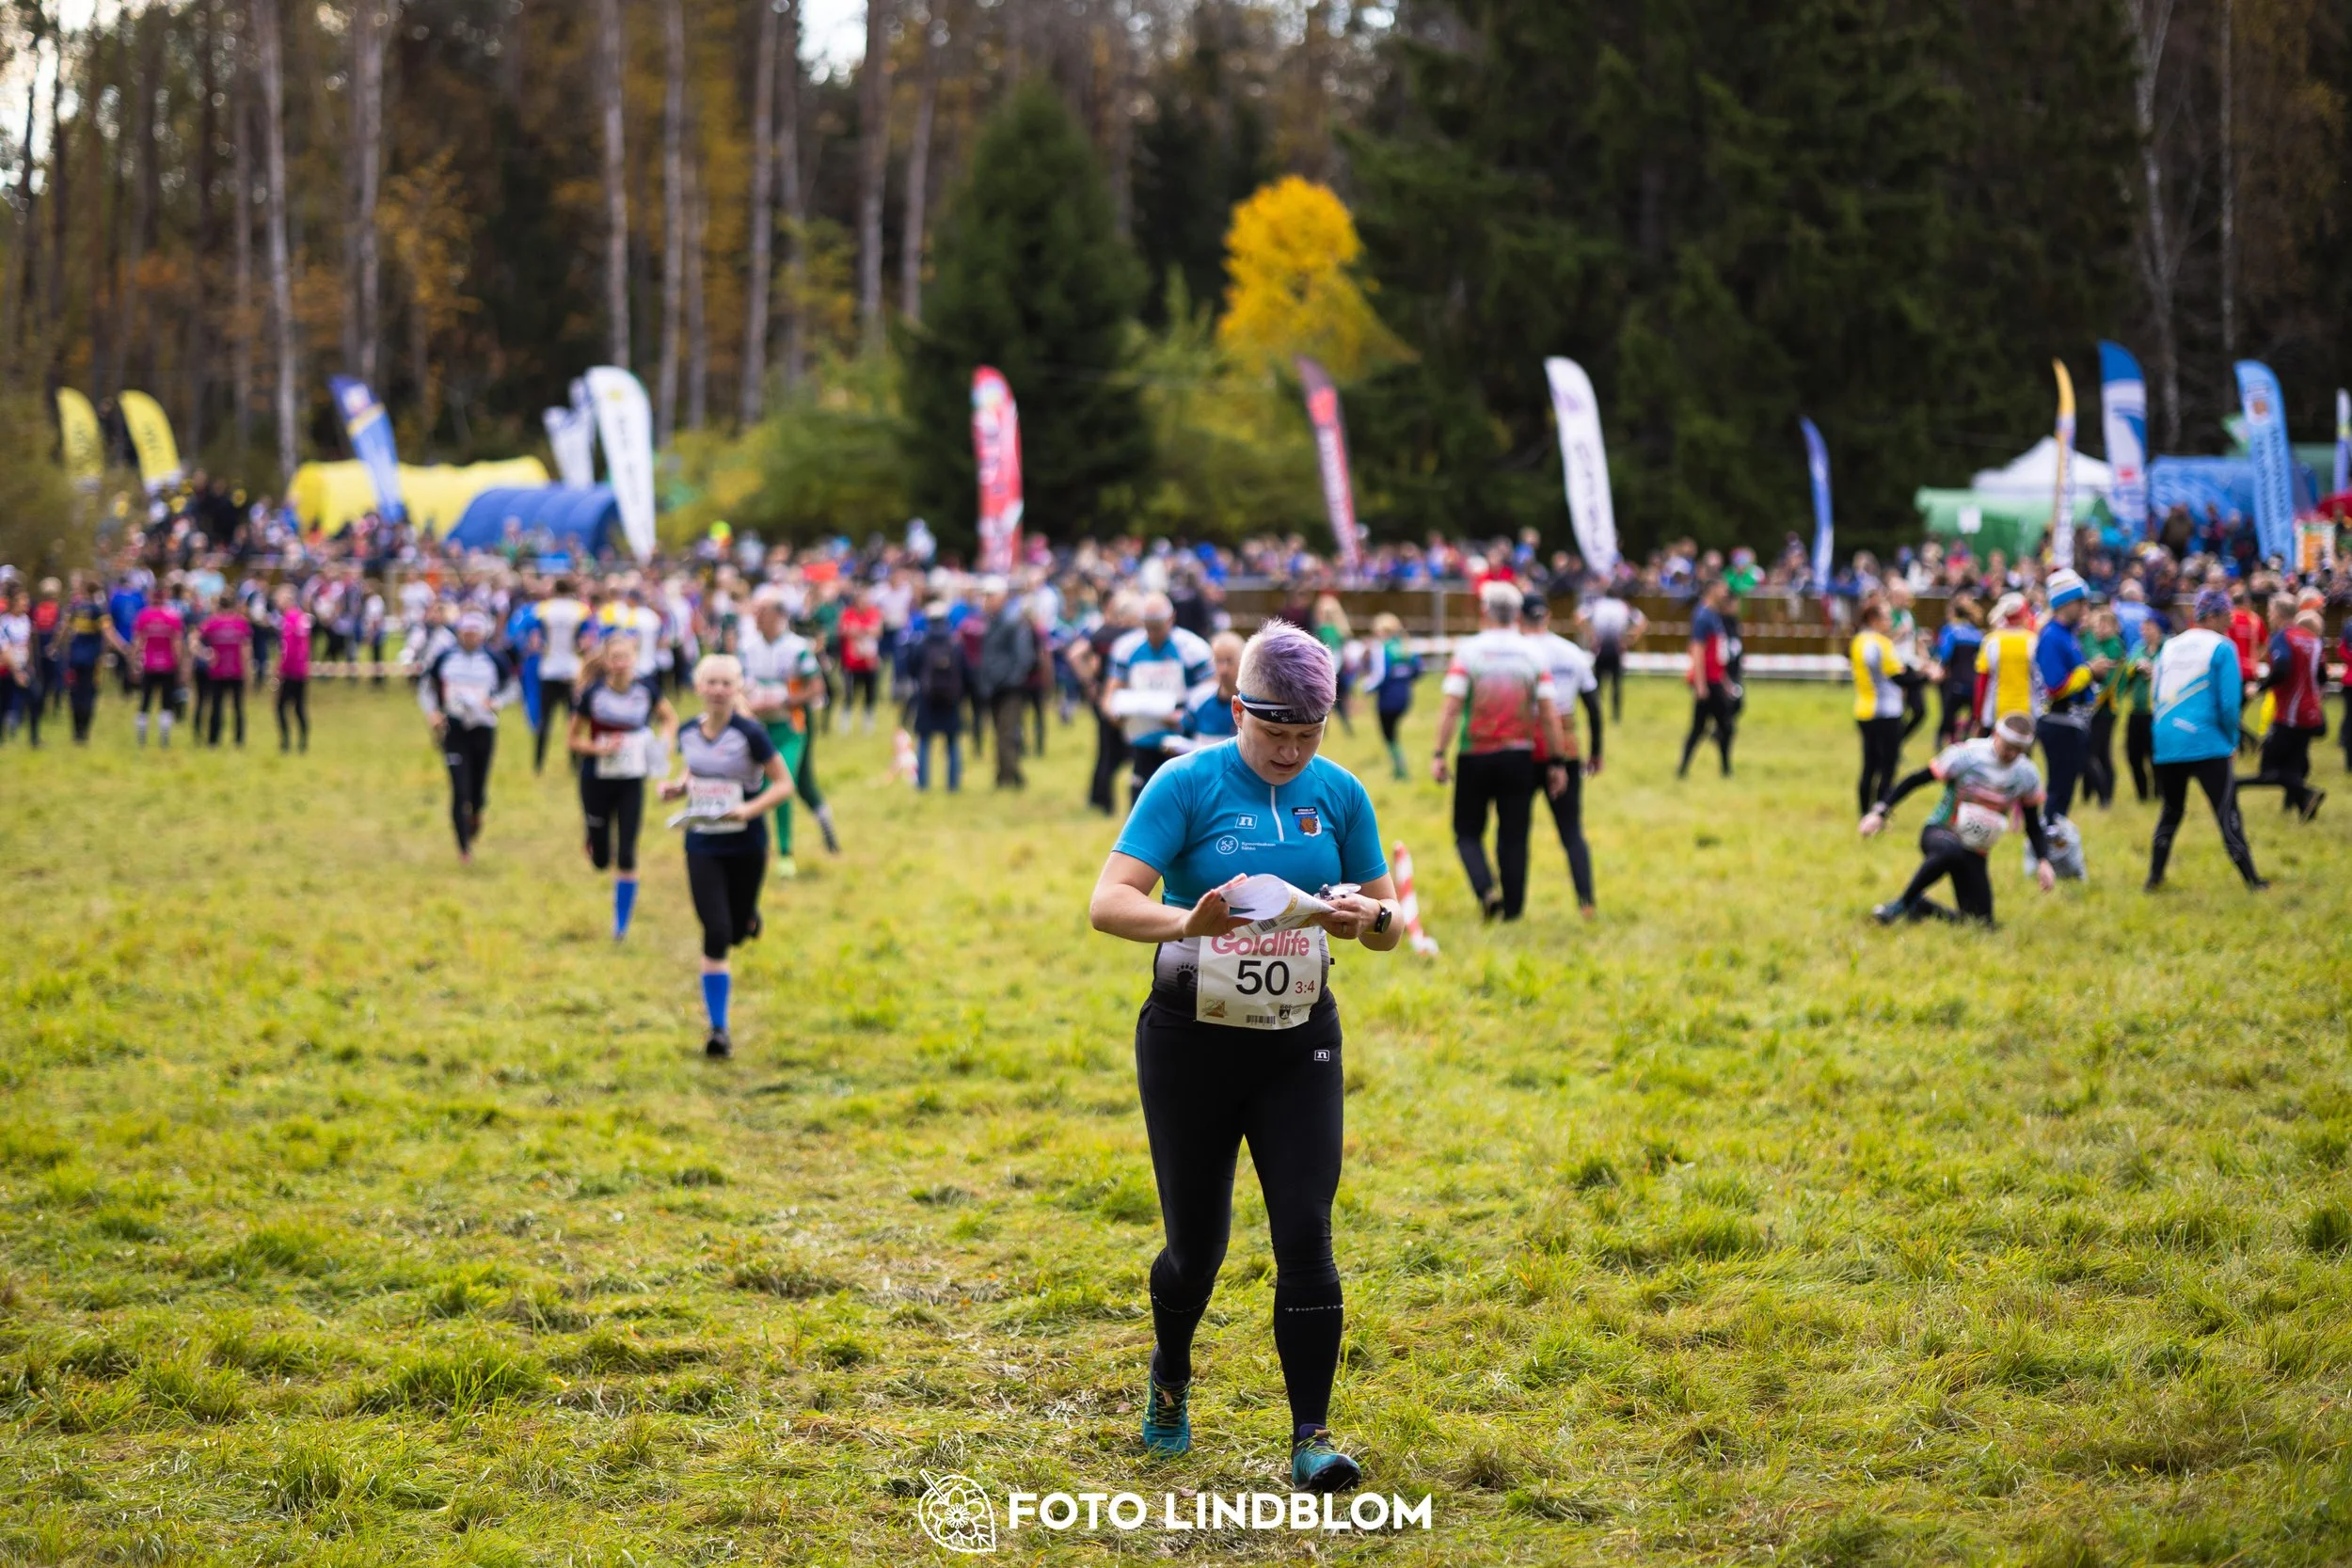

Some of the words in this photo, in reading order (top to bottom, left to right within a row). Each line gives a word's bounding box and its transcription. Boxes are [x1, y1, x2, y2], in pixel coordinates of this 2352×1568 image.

[1211, 930, 1310, 957] Goldlife
[1235, 959, 1290, 996] 50
[1295, 980, 1315, 994] 3:4
